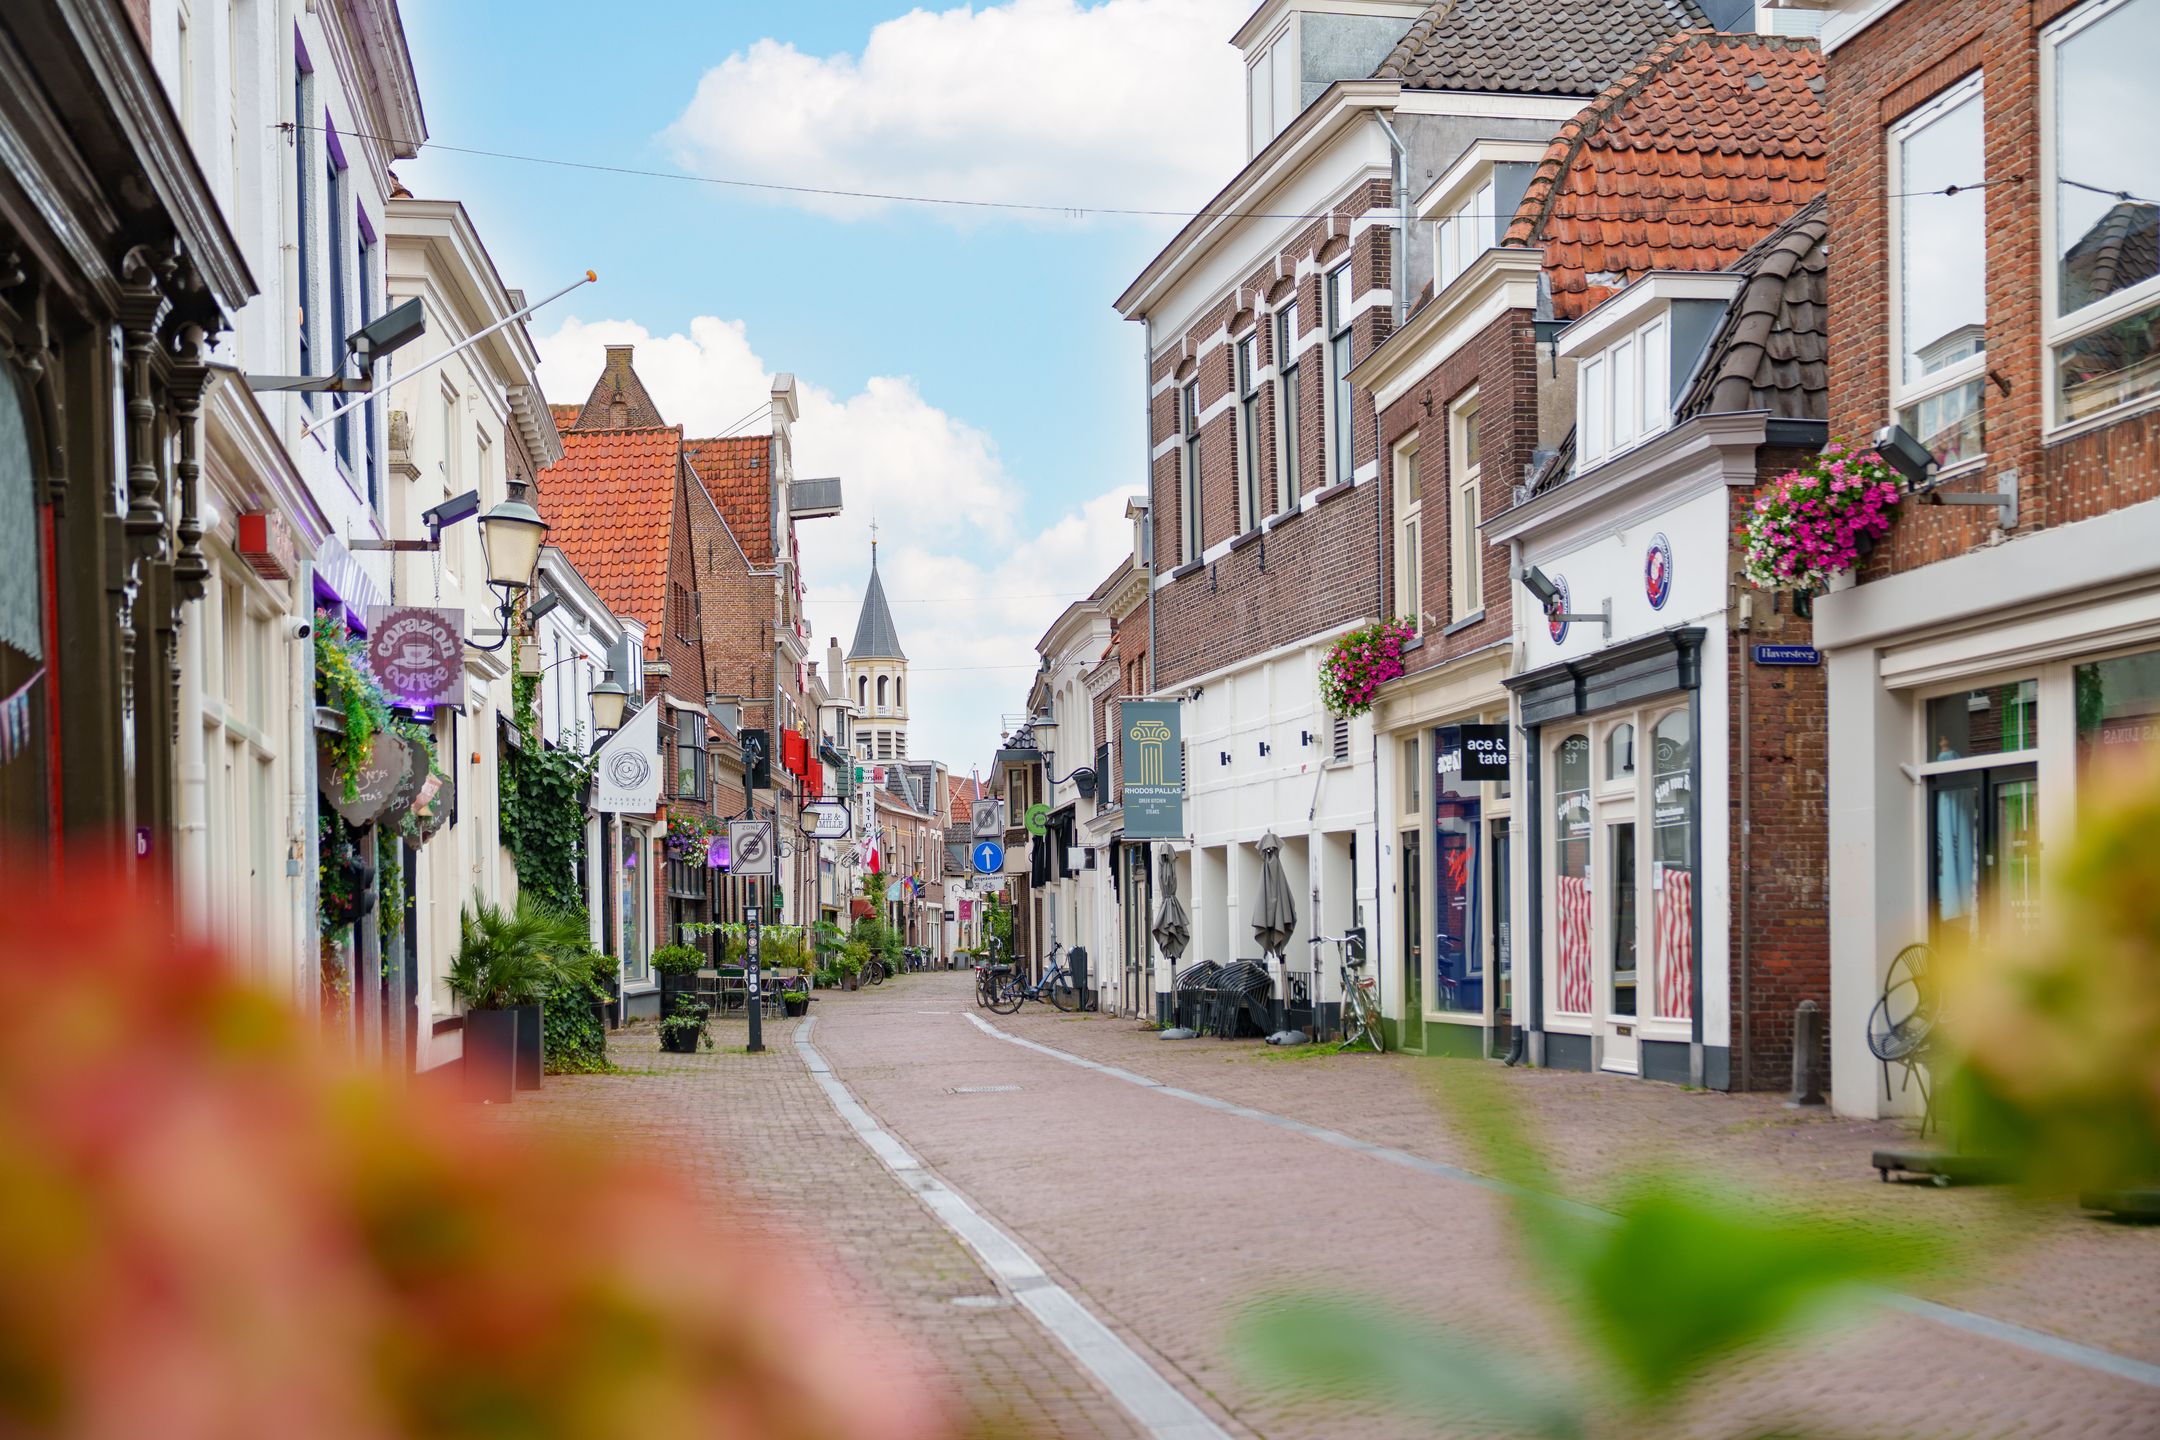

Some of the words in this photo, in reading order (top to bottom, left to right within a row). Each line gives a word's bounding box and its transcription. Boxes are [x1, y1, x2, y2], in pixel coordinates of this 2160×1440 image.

[378, 618, 456, 659] corazon
[1761, 648, 1816, 661] Haversteeg
[1467, 739, 1493, 751] ace
[1495, 738, 1506, 751] &
[1478, 752, 1507, 765] tate
[834, 812, 841, 820] &
